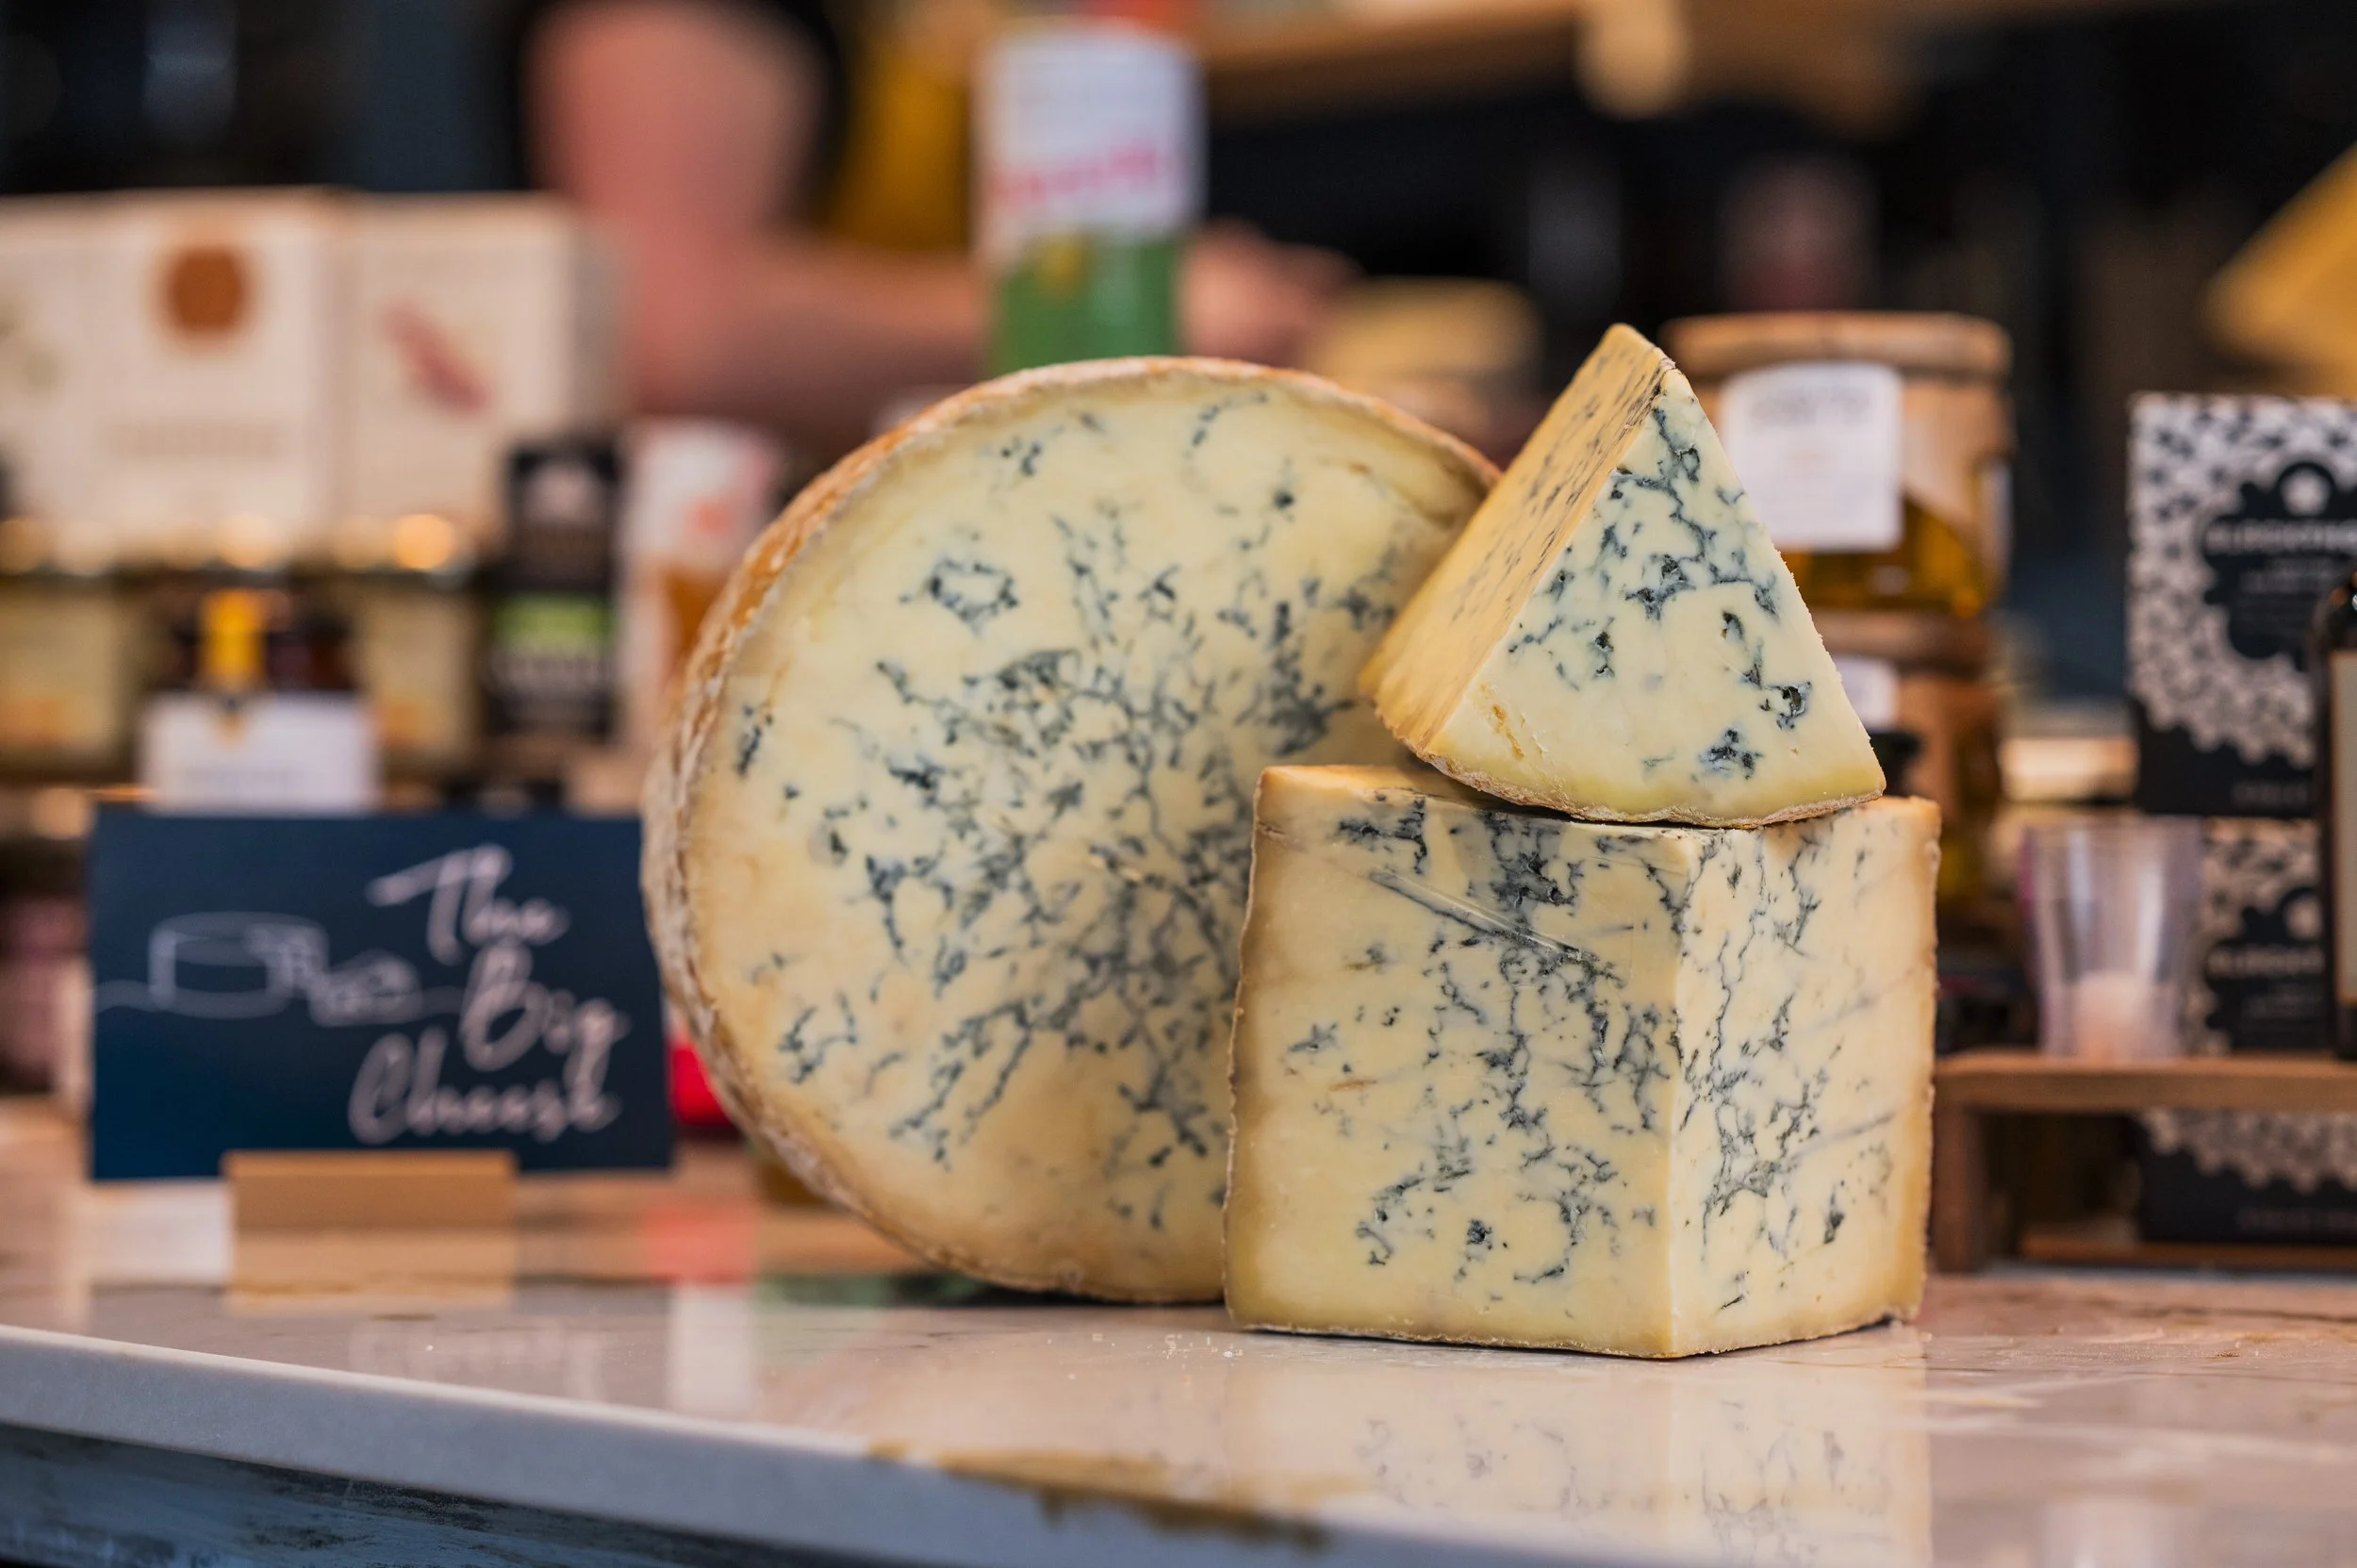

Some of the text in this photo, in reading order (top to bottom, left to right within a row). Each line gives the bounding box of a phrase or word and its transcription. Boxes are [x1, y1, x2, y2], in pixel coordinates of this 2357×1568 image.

[369, 845, 569, 963] The
[460, 942, 628, 1105] Big
[349, 1030, 620, 1143] Cheese
